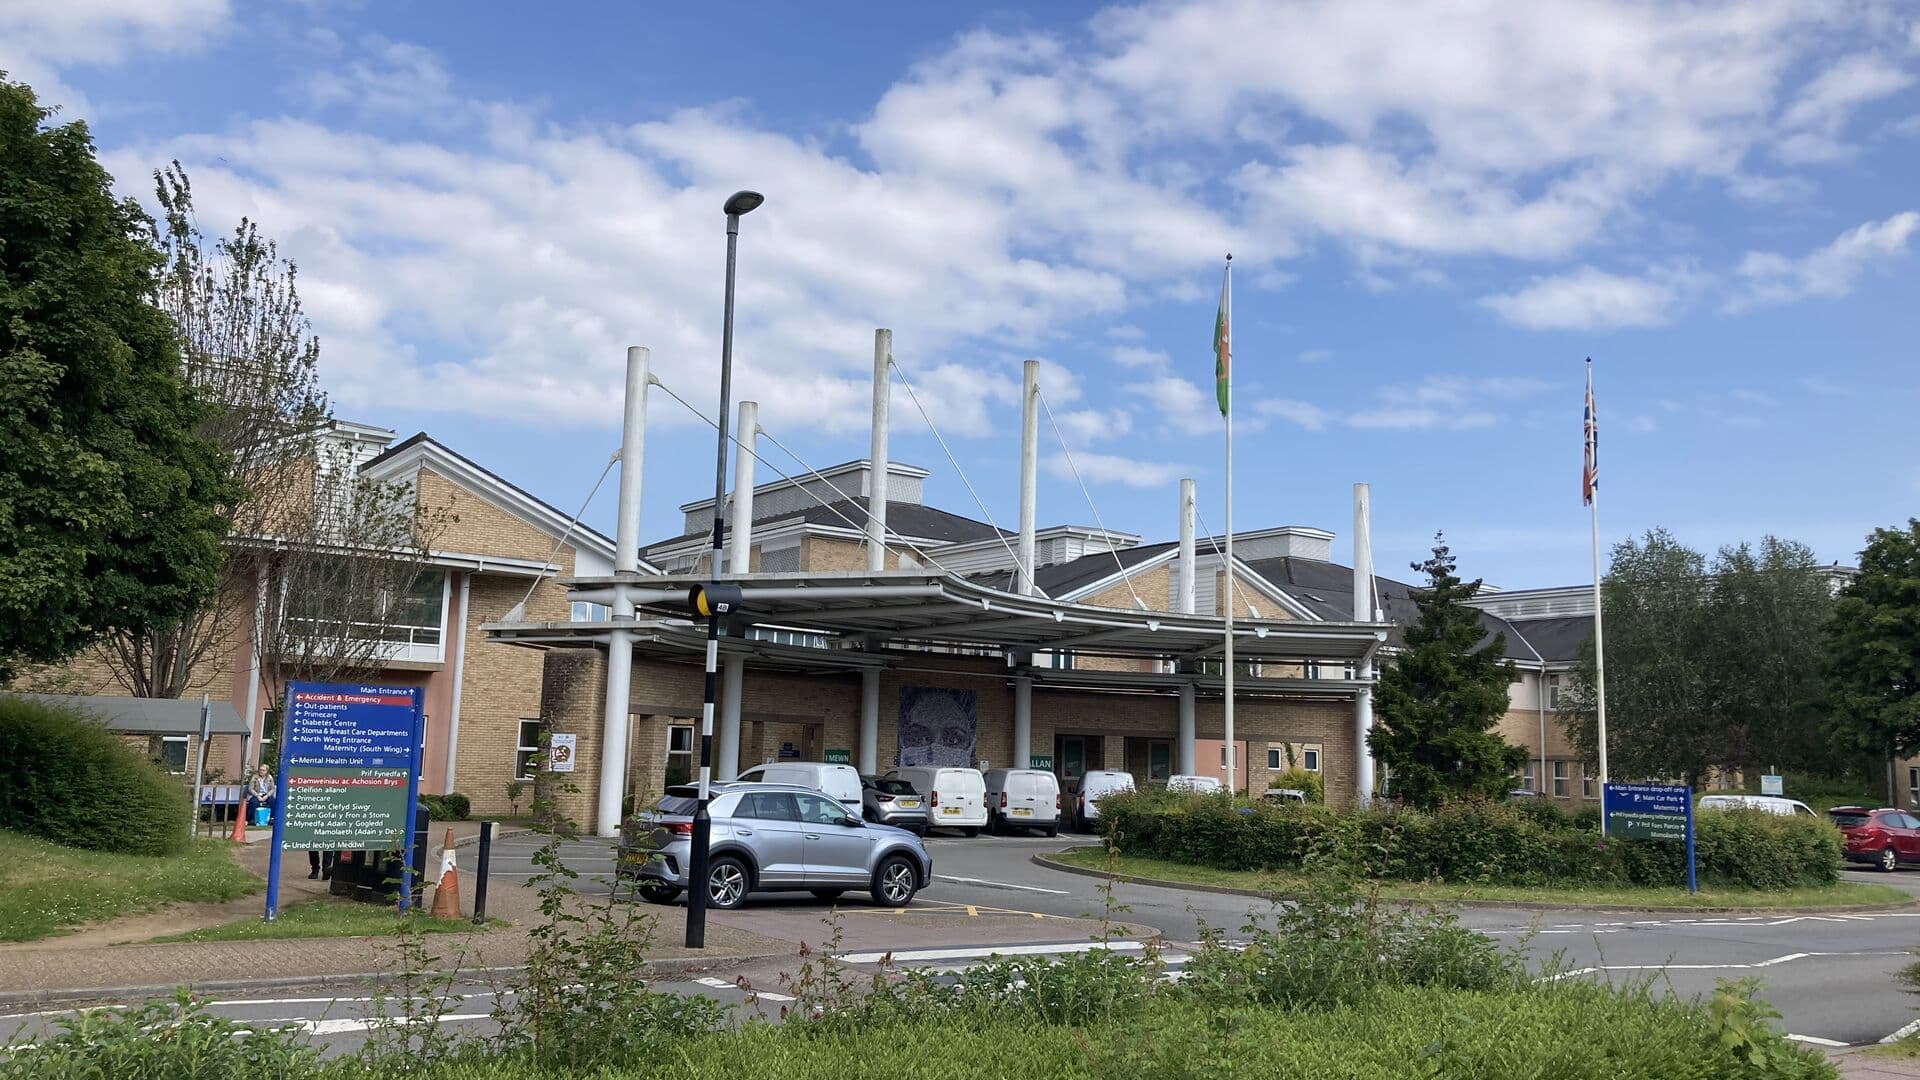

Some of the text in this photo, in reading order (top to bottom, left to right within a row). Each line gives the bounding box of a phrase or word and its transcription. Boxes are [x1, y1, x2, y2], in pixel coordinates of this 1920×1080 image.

[1032, 760, 1051, 768] LLAN
[294, 820, 324, 828] Mynedfa
[313, 841, 335, 849] Iechyd
